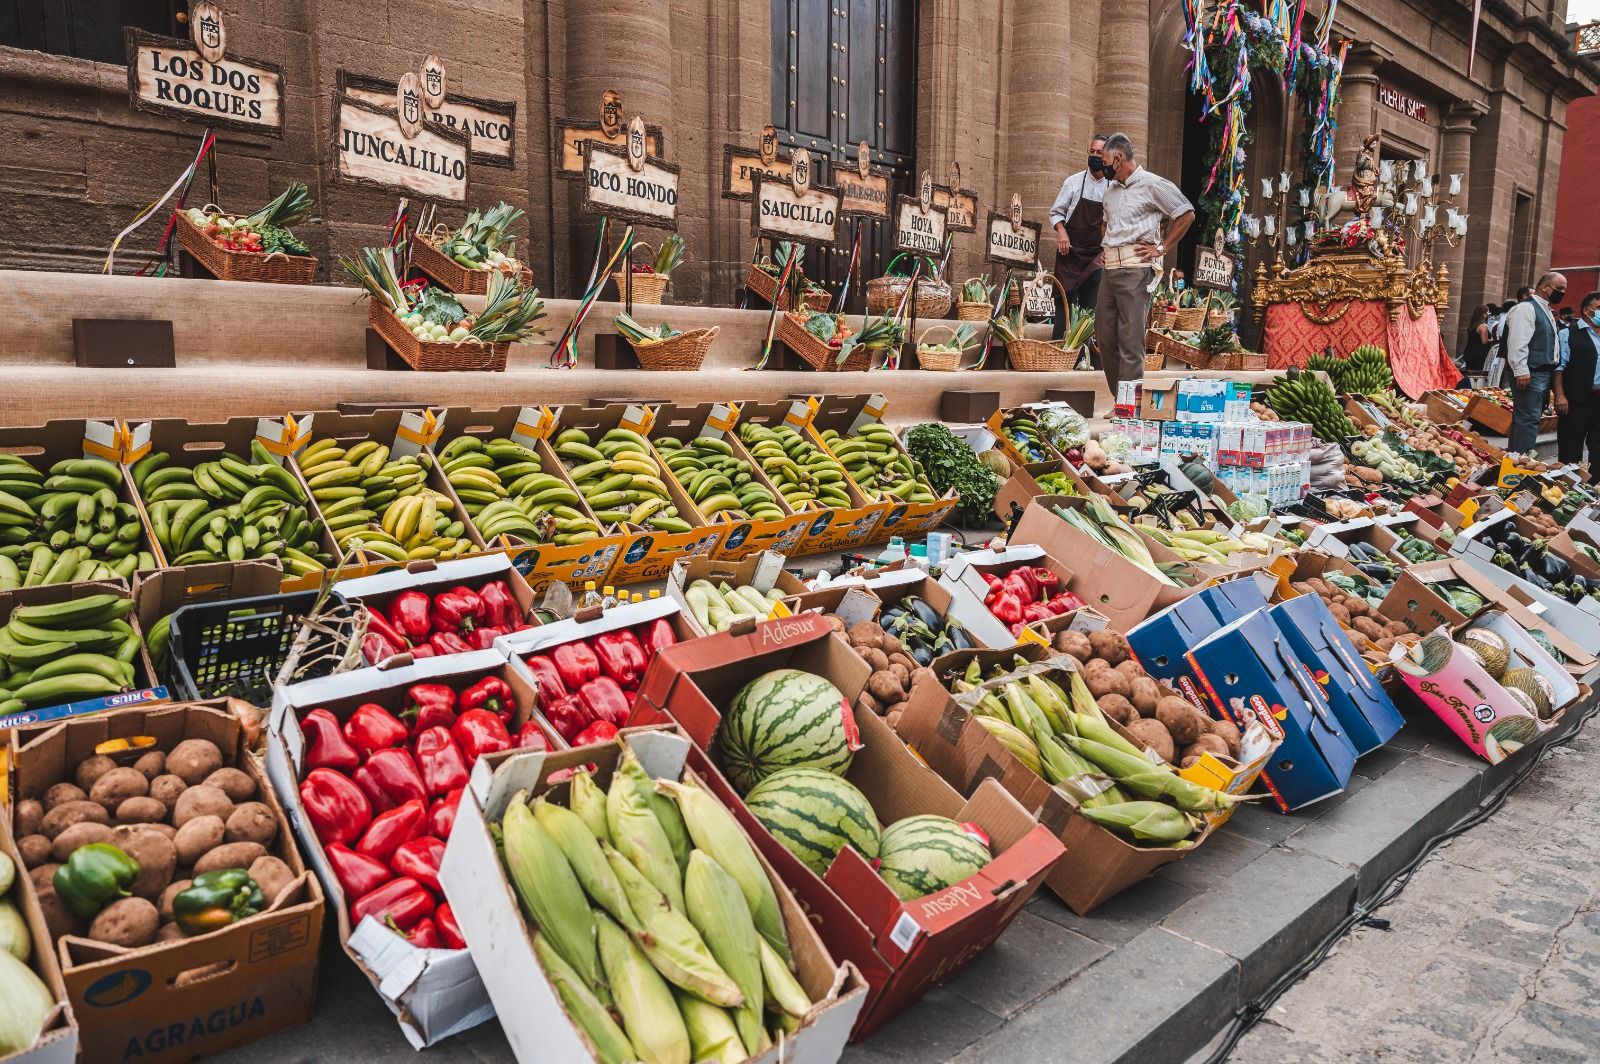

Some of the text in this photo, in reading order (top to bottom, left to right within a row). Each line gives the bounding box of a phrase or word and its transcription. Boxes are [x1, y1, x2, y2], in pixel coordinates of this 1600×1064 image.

[151, 50, 261, 95] LOS DOS
[155, 78, 262, 119] ROQUES
[340, 129, 465, 181] JUNCALILLO
[590, 168, 677, 206] BCO. HONDO
[761, 199, 834, 226] SAUCILLO
[911, 215, 933, 235] HOYA
[900, 230, 942, 252] DE PINEDA
[991, 232, 1035, 254] CAIDEROS
[1204, 256, 1226, 272] PUNTA
[762, 620, 815, 646] Adesur
[111, 692, 141, 705] RIUS
[921, 882, 983, 919] Adesur
[122, 996, 266, 1062] AGRAGUA
